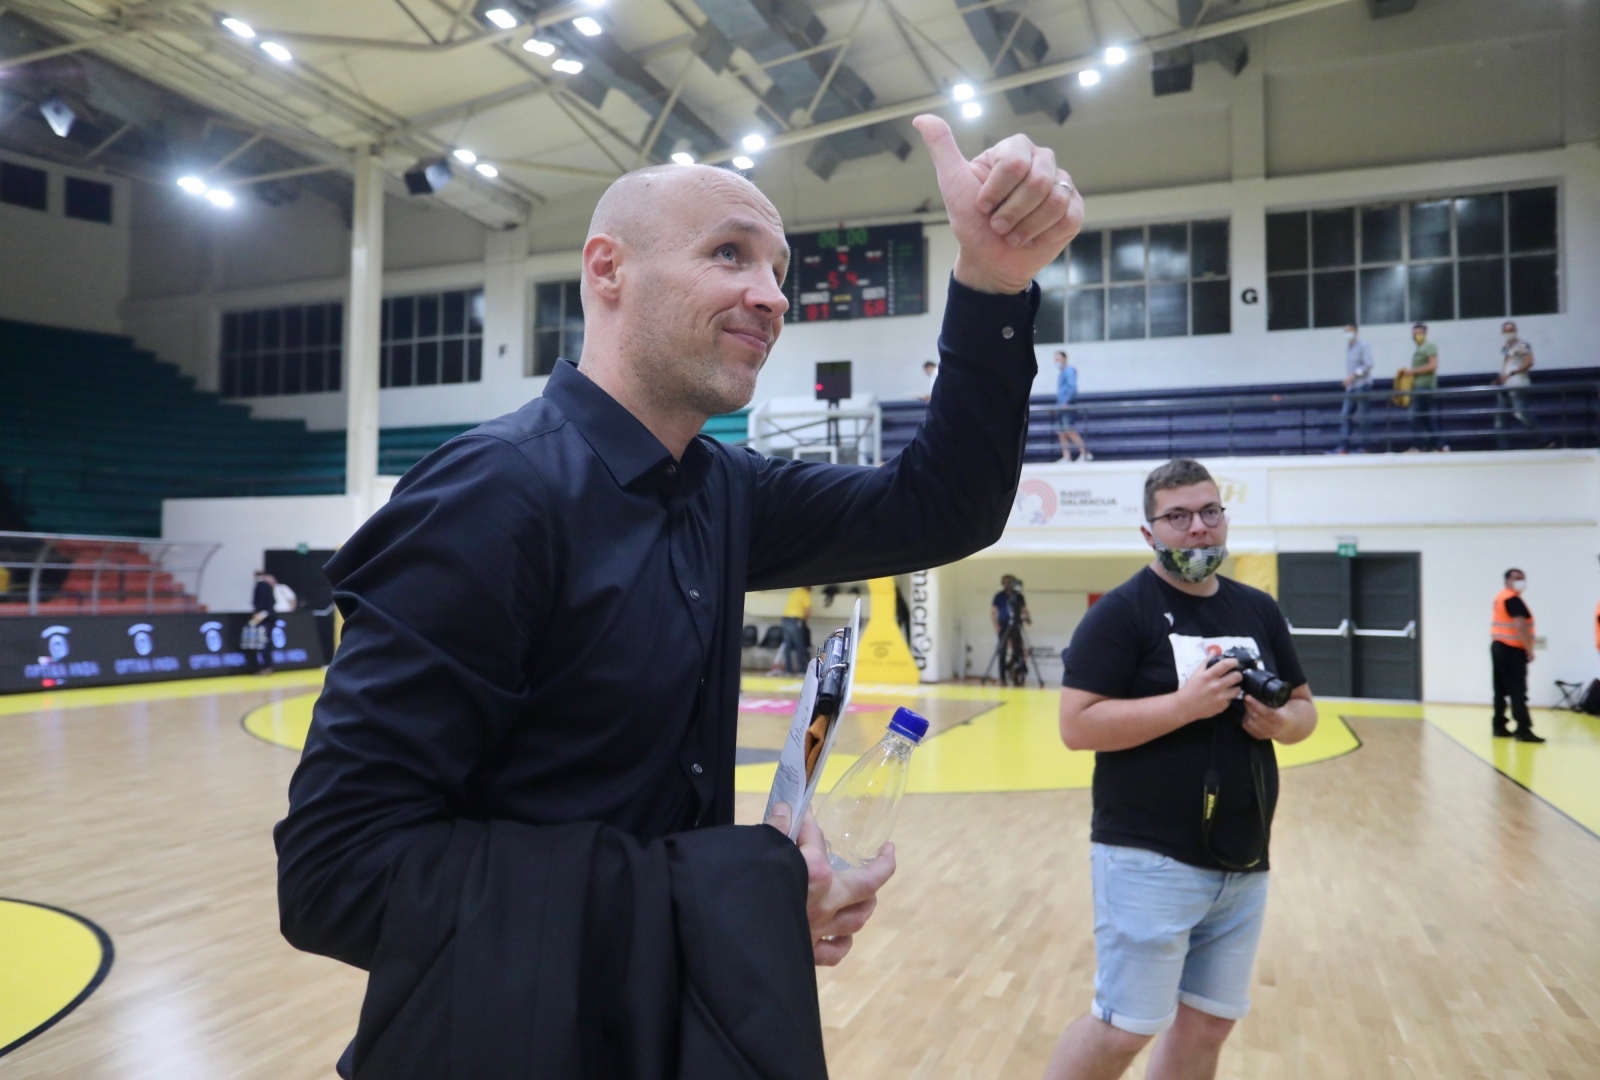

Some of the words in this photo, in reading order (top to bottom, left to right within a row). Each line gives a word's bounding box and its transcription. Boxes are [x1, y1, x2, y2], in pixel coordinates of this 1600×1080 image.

[1241, 287, 1258, 305] G
[1060, 489, 1092, 497] RADIO
[1060, 497, 1117, 506] DALMACIJA
